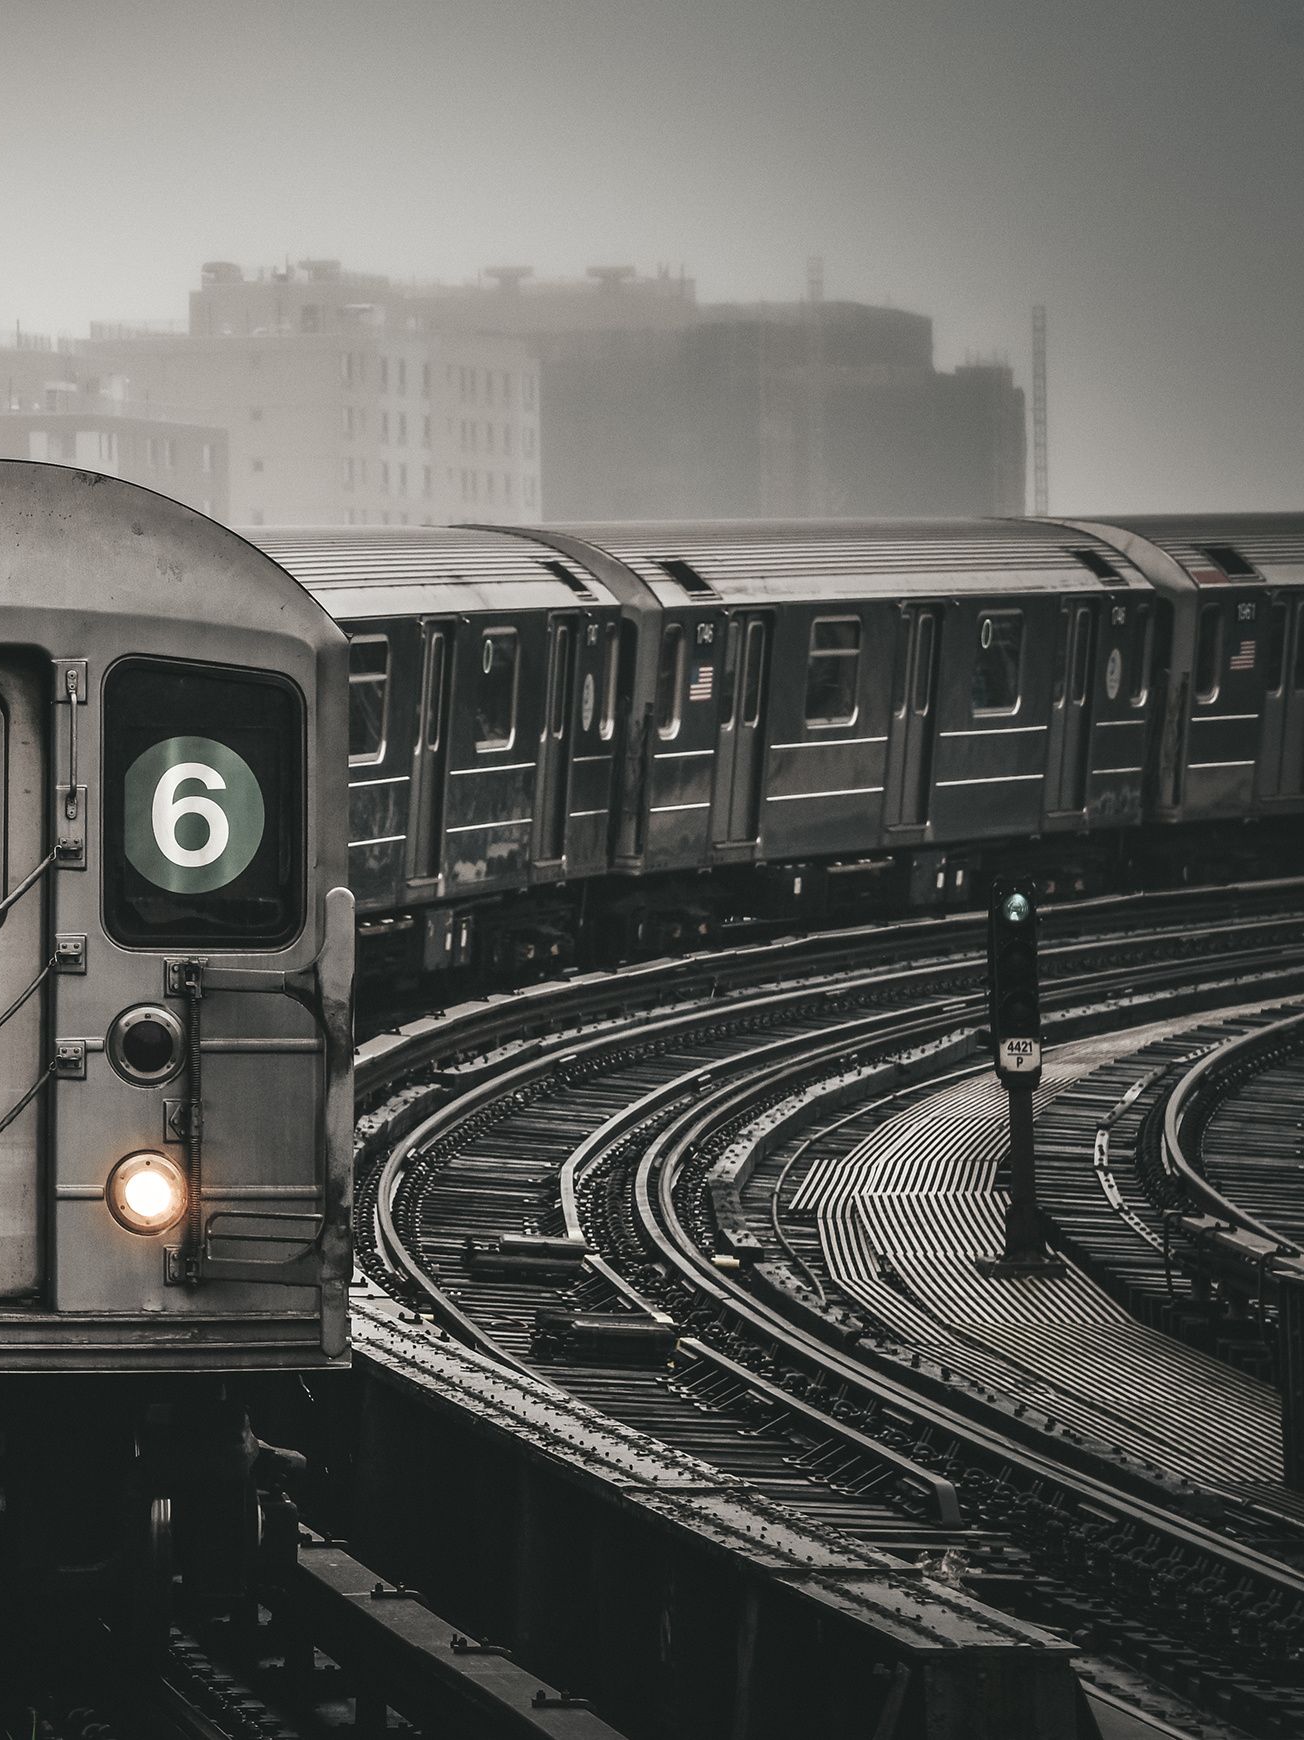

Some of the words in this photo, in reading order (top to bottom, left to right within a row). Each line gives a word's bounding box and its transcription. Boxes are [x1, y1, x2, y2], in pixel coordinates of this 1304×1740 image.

[152, 762, 229, 868] 6
[1007, 1041, 1033, 1053] 4421
[1016, 1056, 1024, 1068] P
